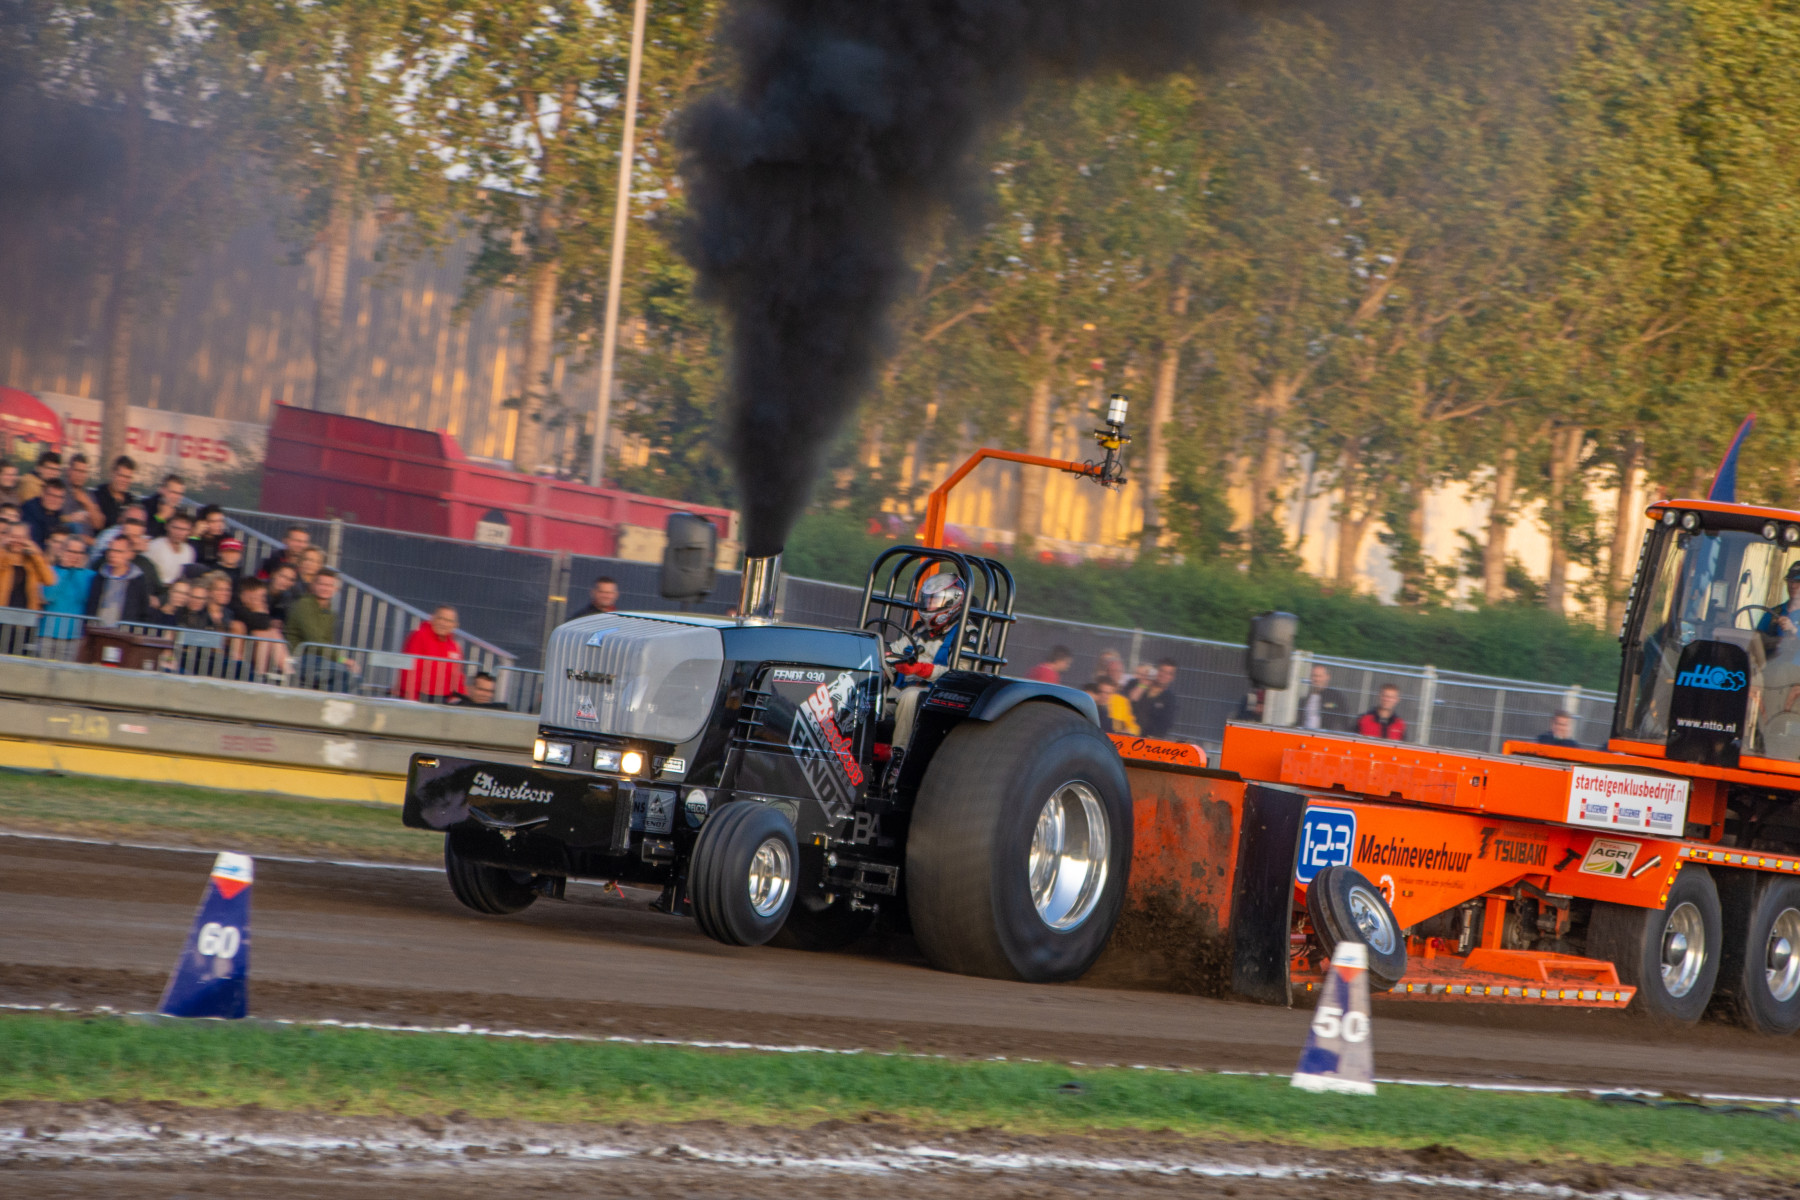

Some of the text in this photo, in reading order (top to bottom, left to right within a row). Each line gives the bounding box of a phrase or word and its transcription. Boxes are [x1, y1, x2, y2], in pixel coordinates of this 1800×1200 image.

[772, 669, 825, 683] FENDT 930
[1677, 718, 1736, 733] www.ntto.nl
[1131, 739, 1188, 760] Orange
[790, 714, 848, 819] FENDT
[1575, 774, 1686, 805] starteigenklusbedrijf.nl
[1357, 834, 1473, 873] Machineverhuur
[1494, 839, 1548, 867] TSUBAKI
[1592, 848, 1634, 860] AGRI
[197, 922, 241, 959] 60
[1312, 1006, 1371, 1043] 50
